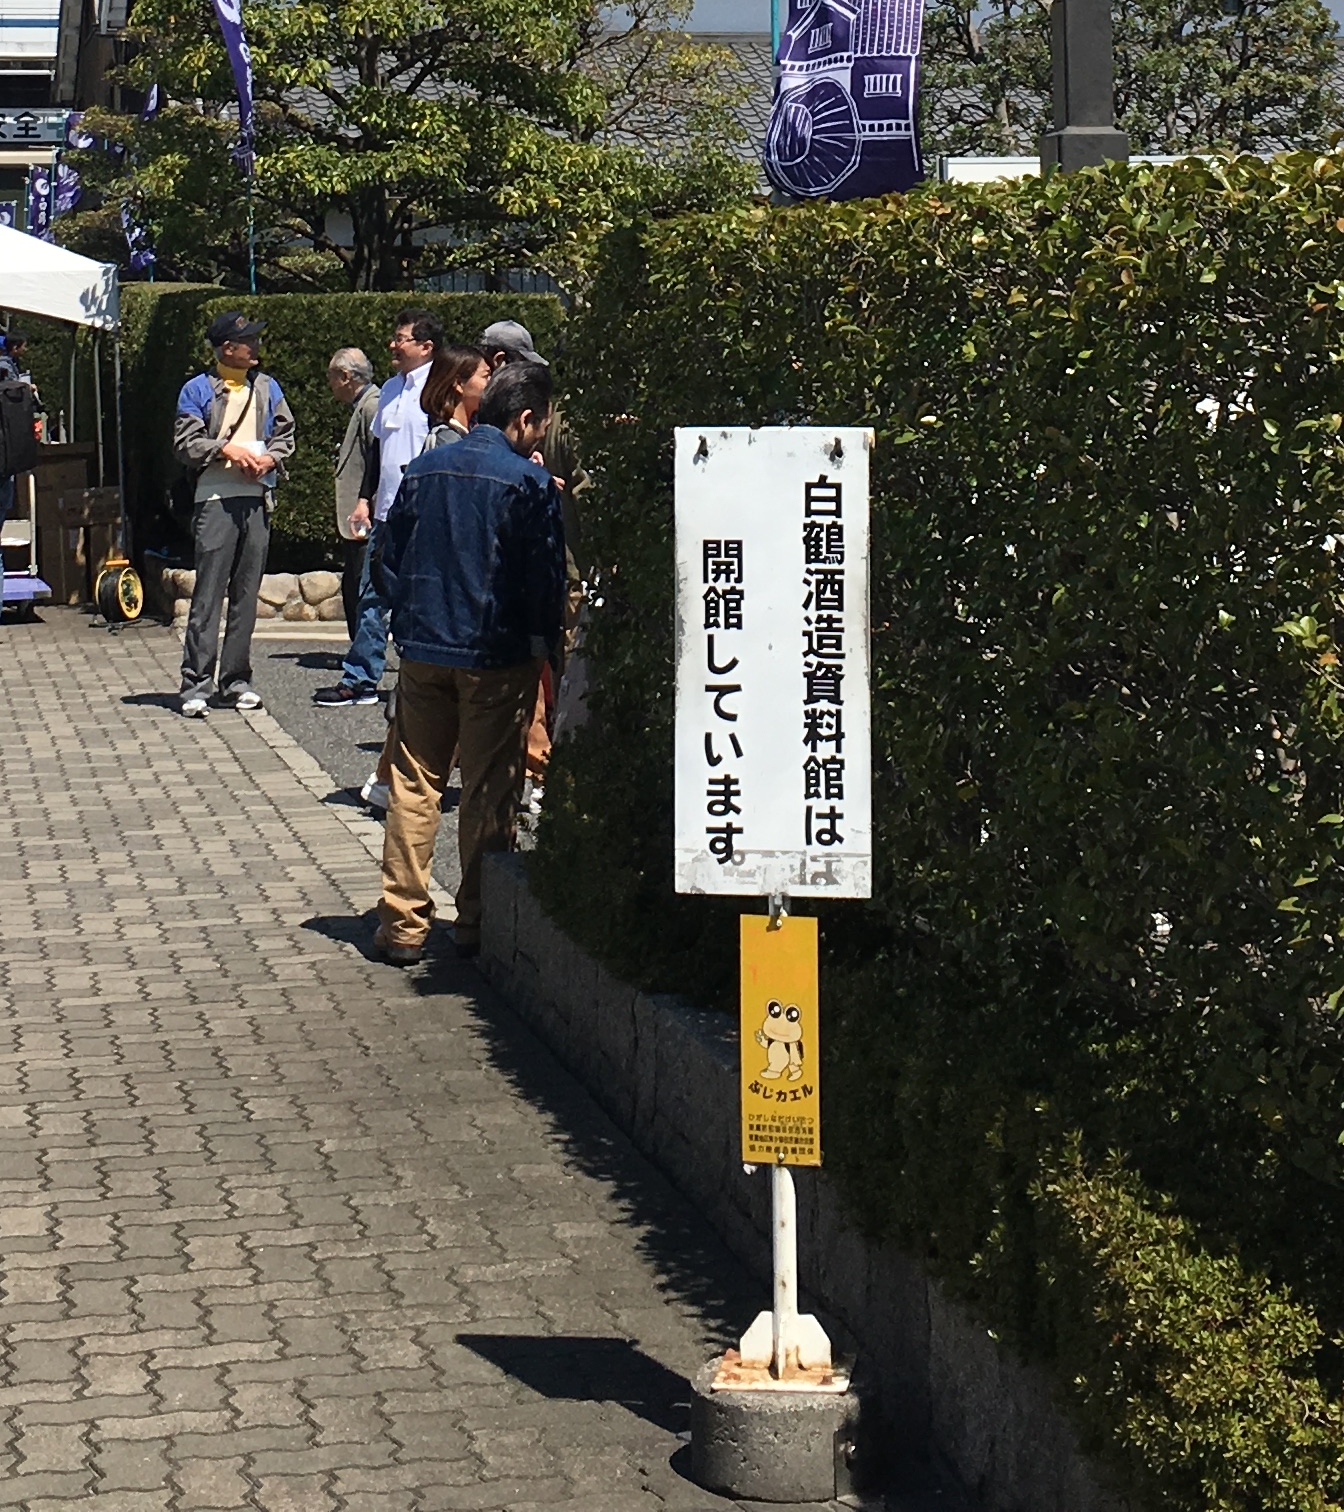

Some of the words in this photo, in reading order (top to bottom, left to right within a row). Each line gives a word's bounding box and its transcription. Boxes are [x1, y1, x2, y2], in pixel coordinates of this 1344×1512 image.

[802, 474, 846, 847] 白鶴酒造資料館は
[748, 1080, 813, 1102] ぶじカエル
